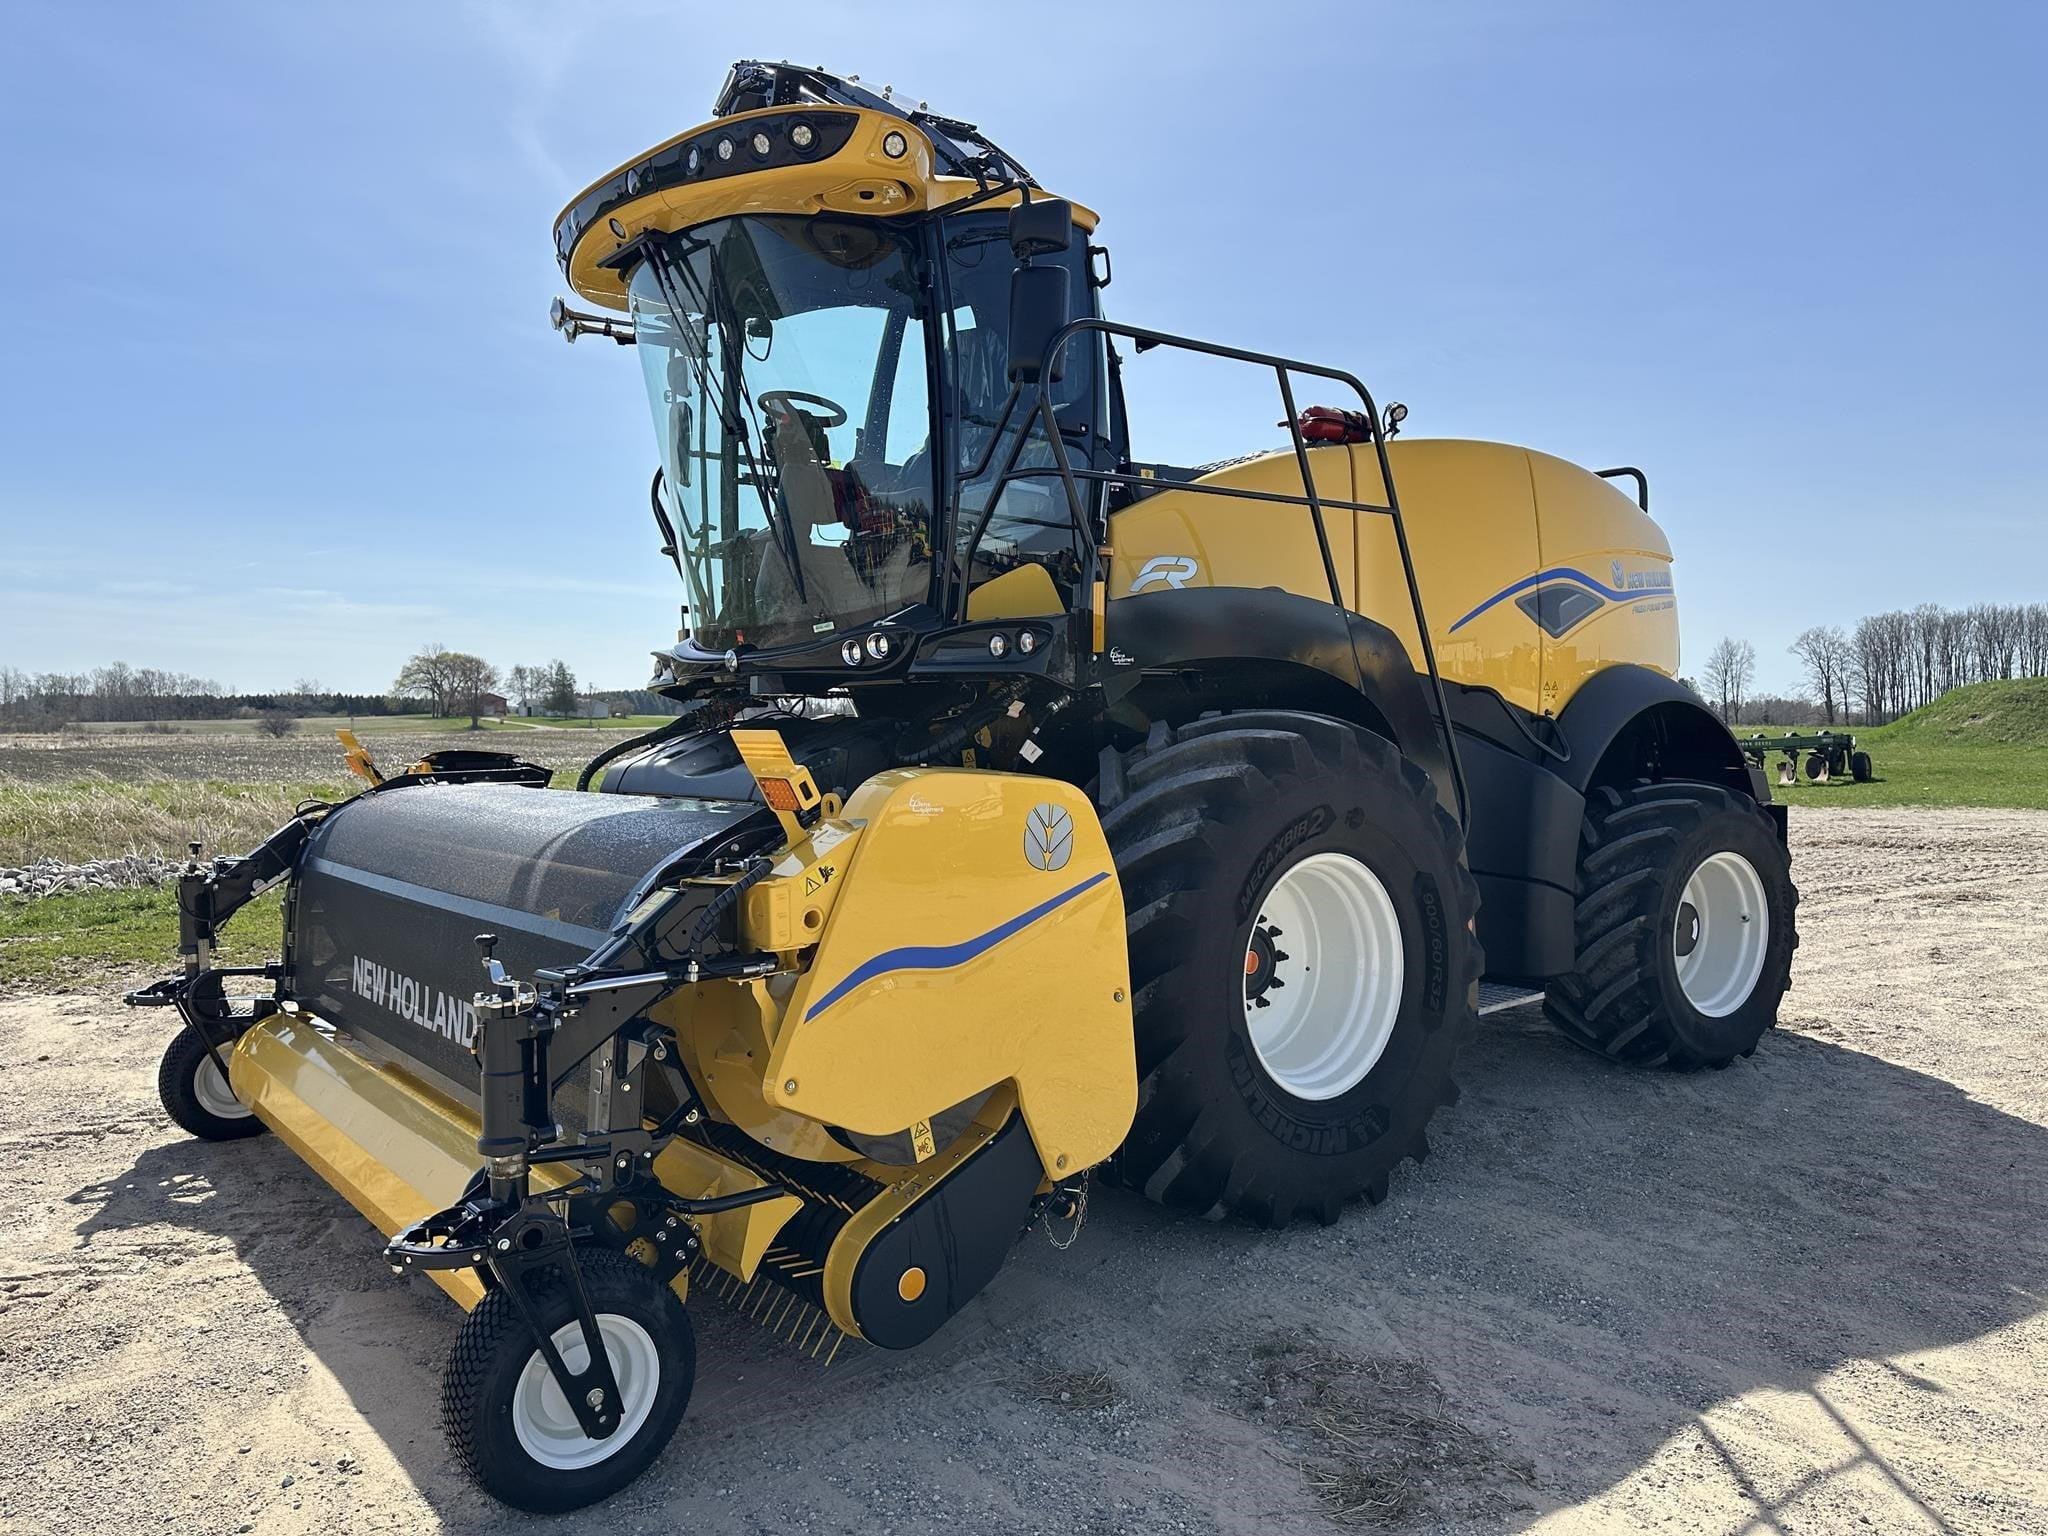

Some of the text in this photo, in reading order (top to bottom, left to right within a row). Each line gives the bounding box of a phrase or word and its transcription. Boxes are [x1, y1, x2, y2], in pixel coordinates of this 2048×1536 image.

[1130, 556, 1198, 593] FR
[352, 955, 477, 1049] NEW HOLLAND
[1229, 1055, 1348, 1155] MICHELIN
